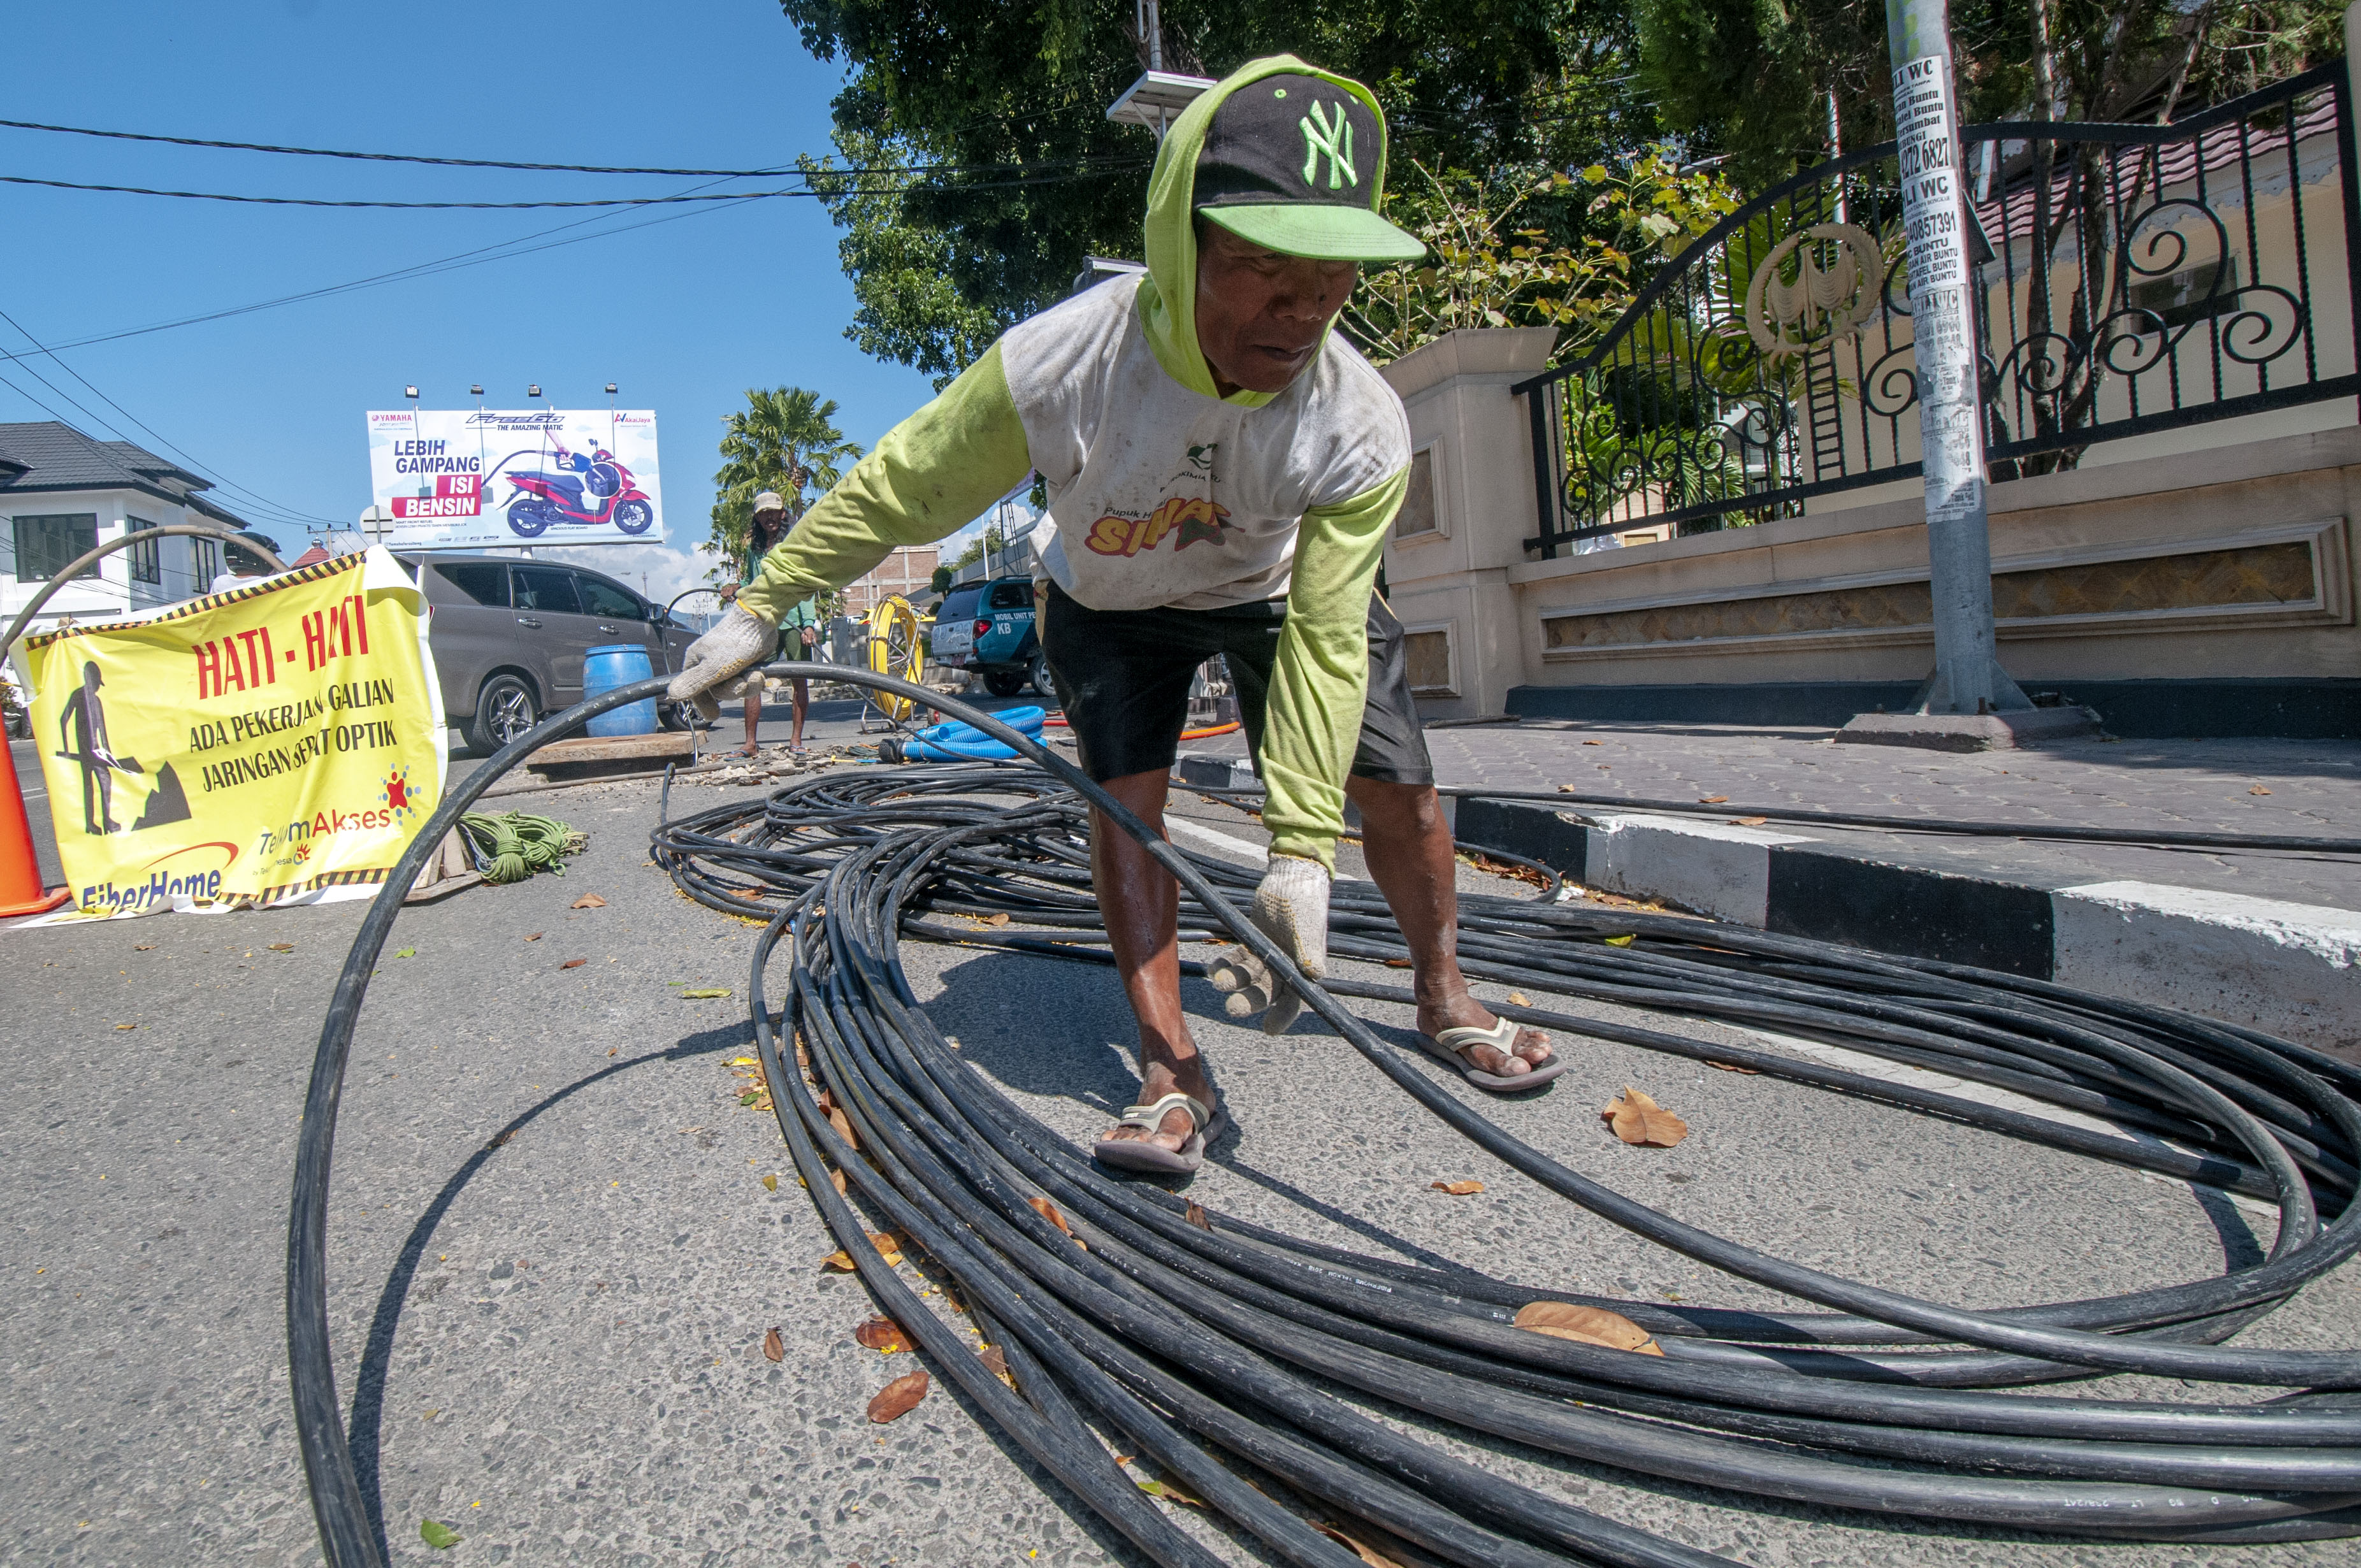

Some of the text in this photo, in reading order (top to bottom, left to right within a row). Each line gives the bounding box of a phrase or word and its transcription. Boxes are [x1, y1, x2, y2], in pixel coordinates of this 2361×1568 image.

[1907, 59, 1933, 80] WC
[1909, 90, 1939, 106] Buntu
[1914, 102, 1943, 117] Buntu
[1299, 99, 1358, 190] NY
[1922, 137, 1949, 171] 6827
[1919, 176, 1948, 199] WC
[1913, 238, 1949, 256] BUNTU
[1920, 253, 1932, 265] AIR
[1933, 247, 1958, 261] BUNTU
[1932, 259, 1957, 272] BUNTU
[1917, 277, 1929, 288] AIR
[1930, 270, 1957, 283] BUNTU
[465, 413, 565, 423] FreeGo
[394, 440, 445, 456] LEBIH
[396, 456, 480, 473] GAMPANG
[449, 476, 474, 494] ISI
[405, 496, 476, 517] BENSIN
[1104, 507, 1139, 518] Pupuk
[994, 611, 1037, 621] MOBIL UNIT PE
[997, 622, 1011, 635] KB
[191, 626, 276, 700] HATI
[302, 594, 369, 673] HATI
[190, 720, 229, 754] ADA
[328, 677, 394, 712] GALIAN
[202, 745, 291, 793] JARINGAN
[335, 719, 398, 752] OPTIK
